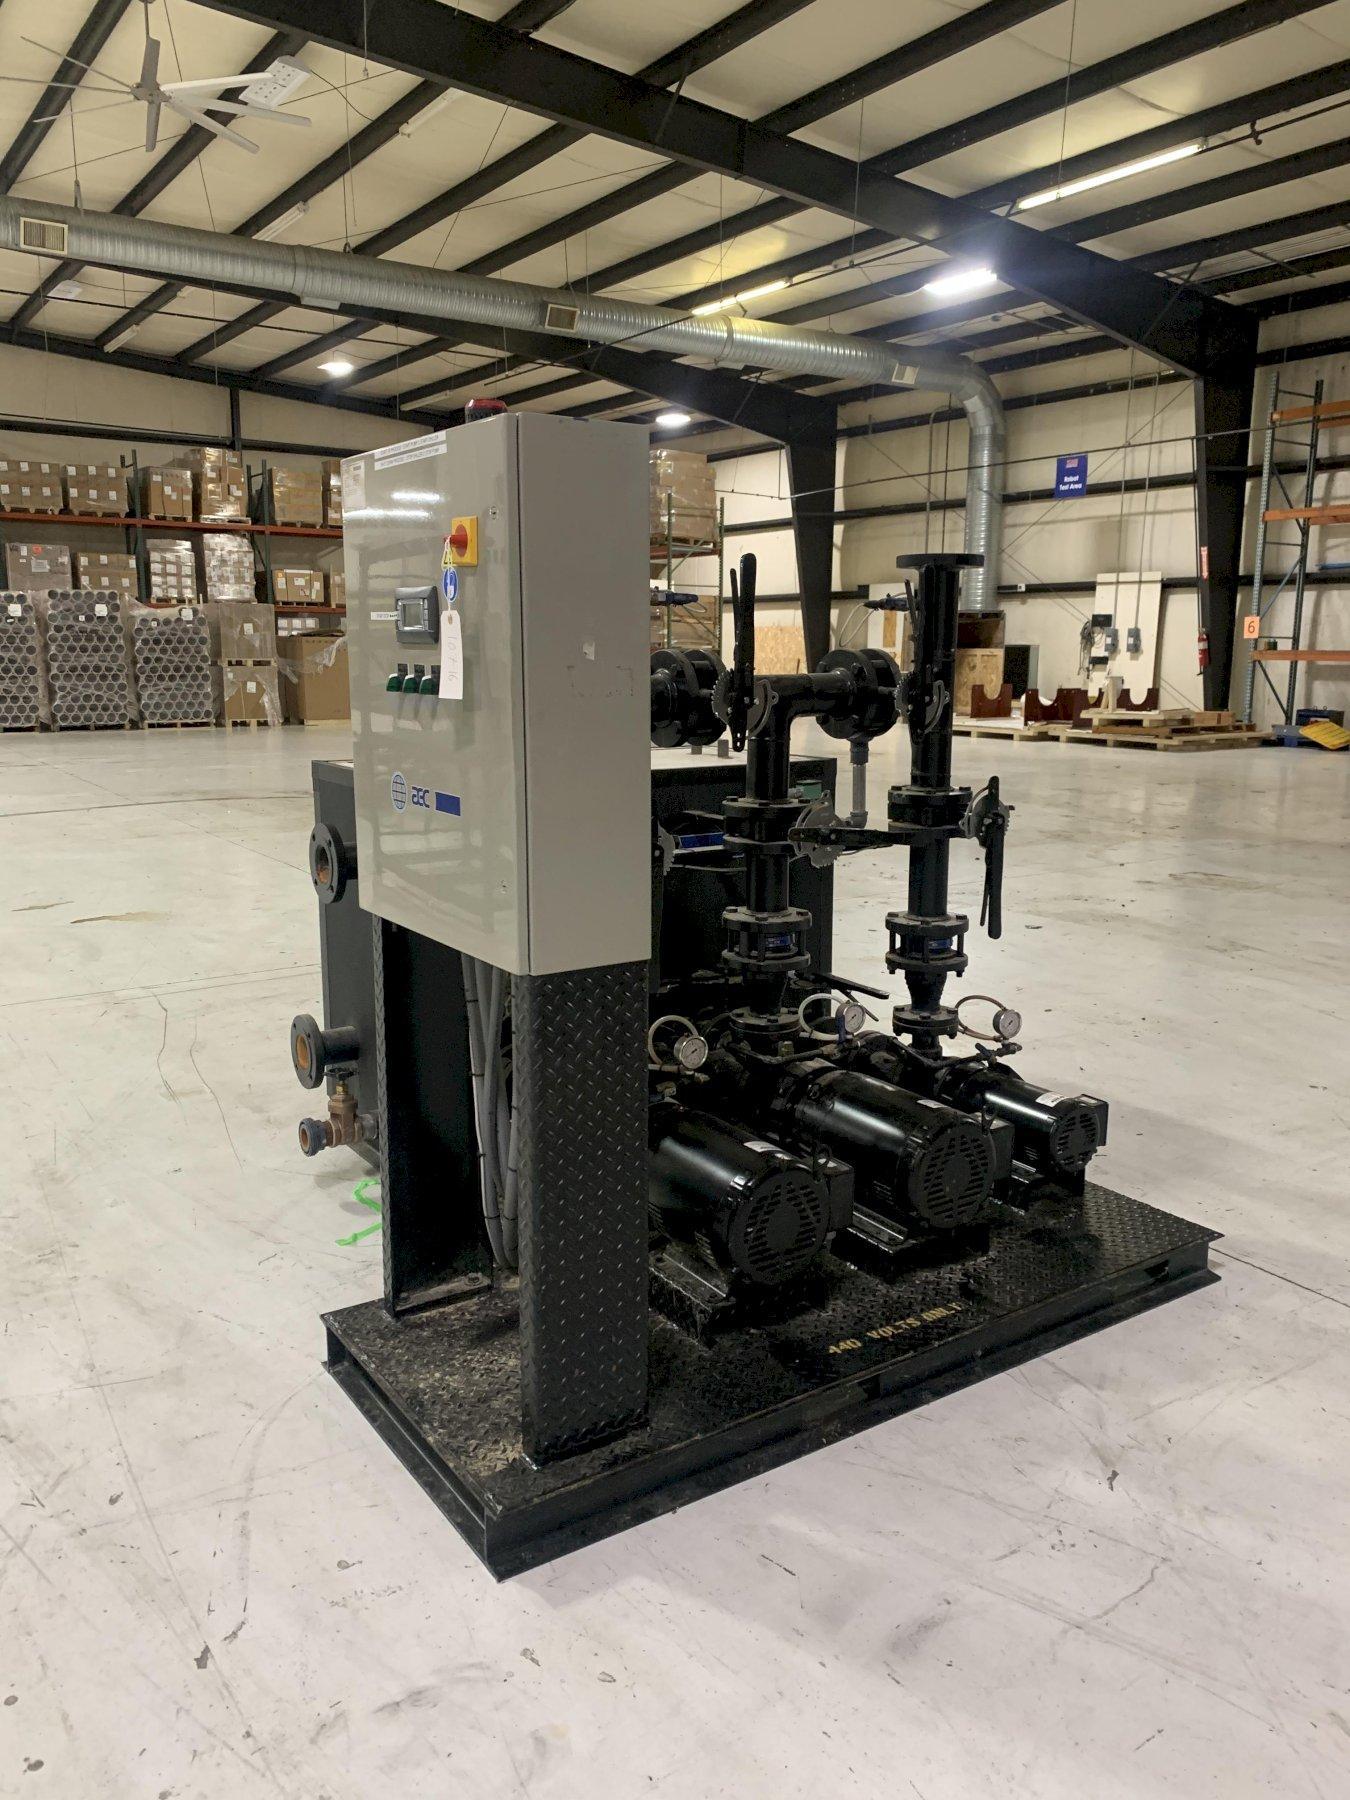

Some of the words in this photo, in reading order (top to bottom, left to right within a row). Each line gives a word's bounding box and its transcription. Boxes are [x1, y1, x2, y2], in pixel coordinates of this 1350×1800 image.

[1247, 620, 1255, 634] 6
[866, 1317, 921, 1339] VOLTS
[921, 1302, 962, 1321] ONLY
